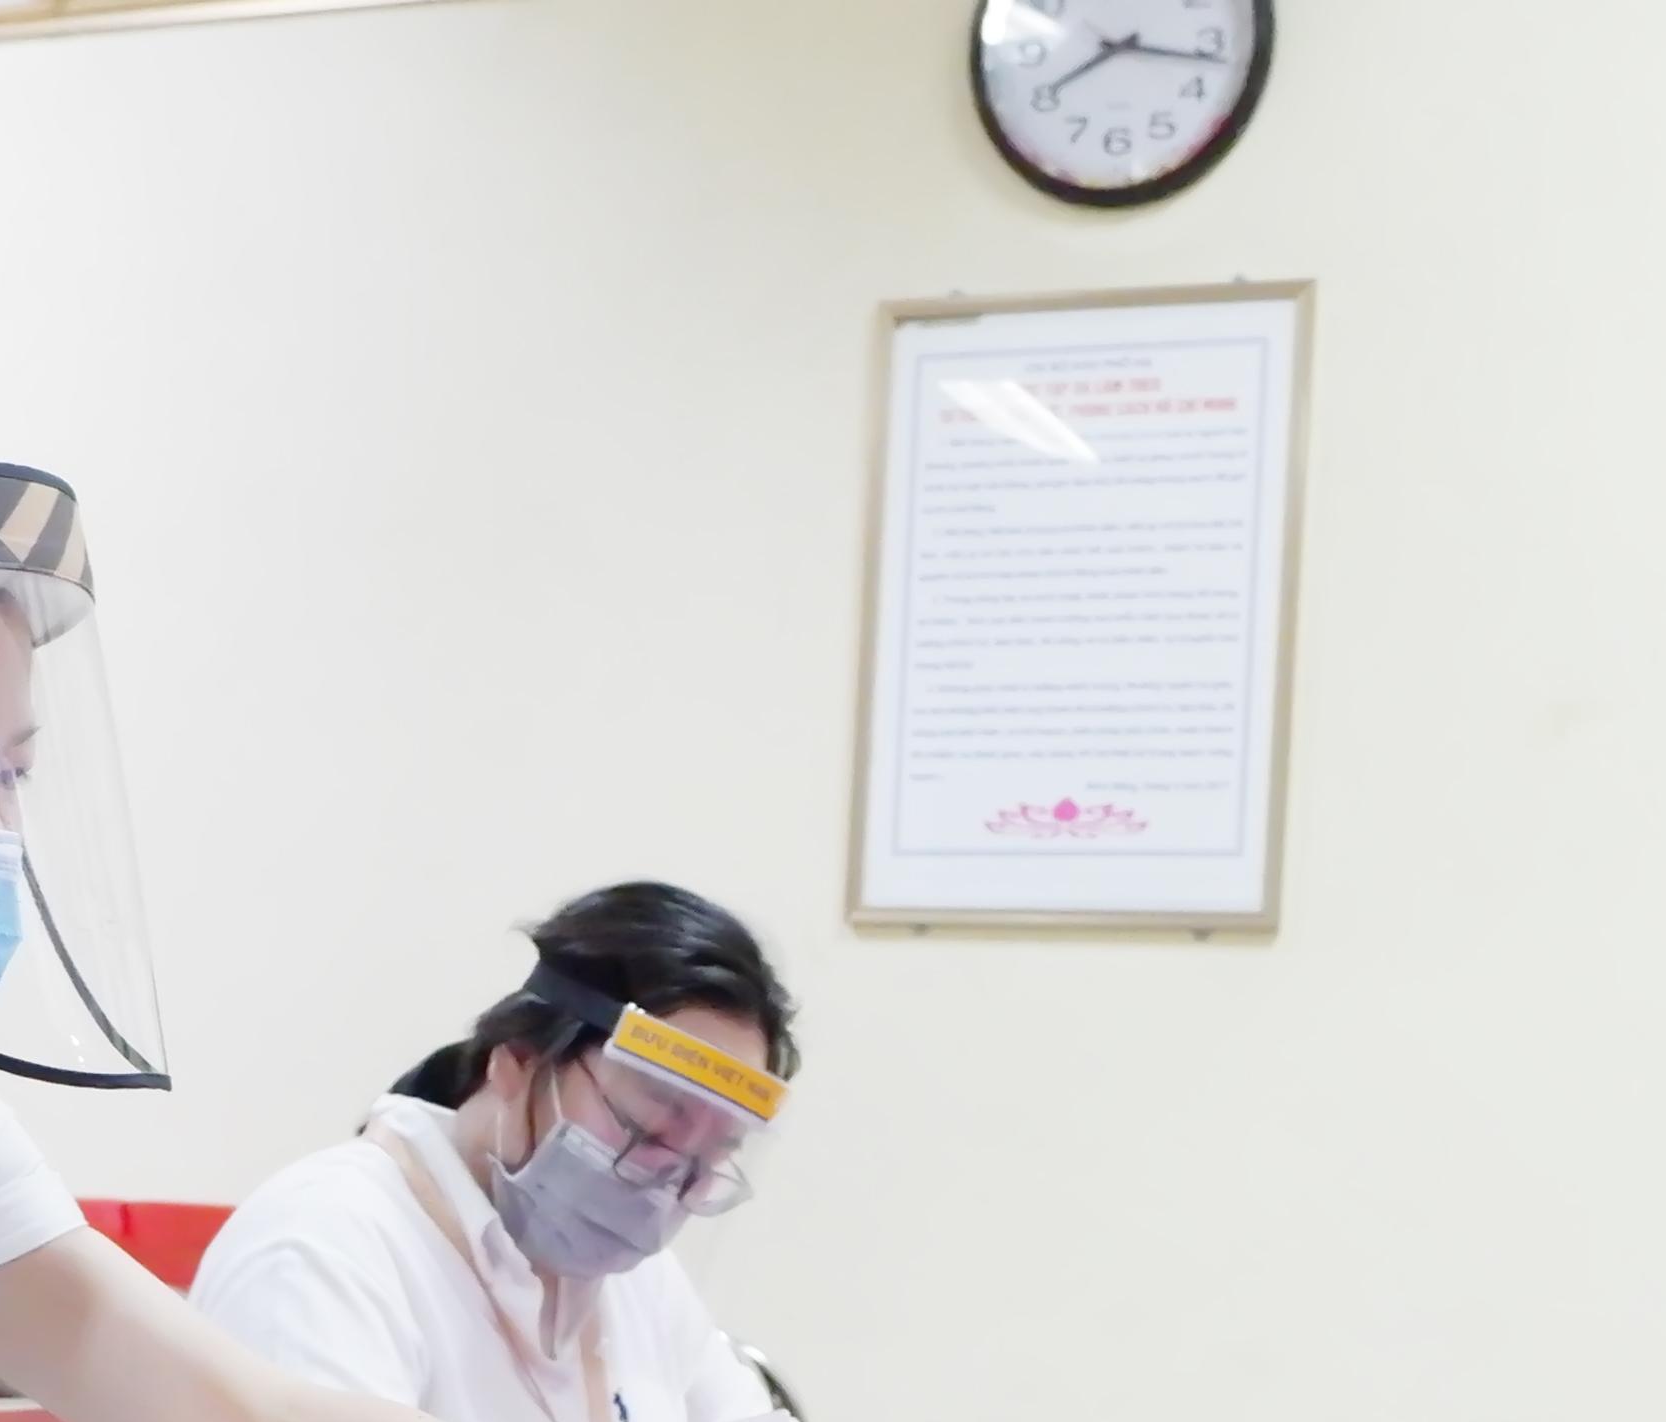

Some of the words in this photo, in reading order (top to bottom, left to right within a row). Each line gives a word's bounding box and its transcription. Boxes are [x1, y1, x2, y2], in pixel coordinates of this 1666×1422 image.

[1179, 76, 1206, 102] 4
[1065, 115, 1089, 144] 7
[1148, 110, 1176, 140] 5
[1102, 127, 1132, 155] 6
